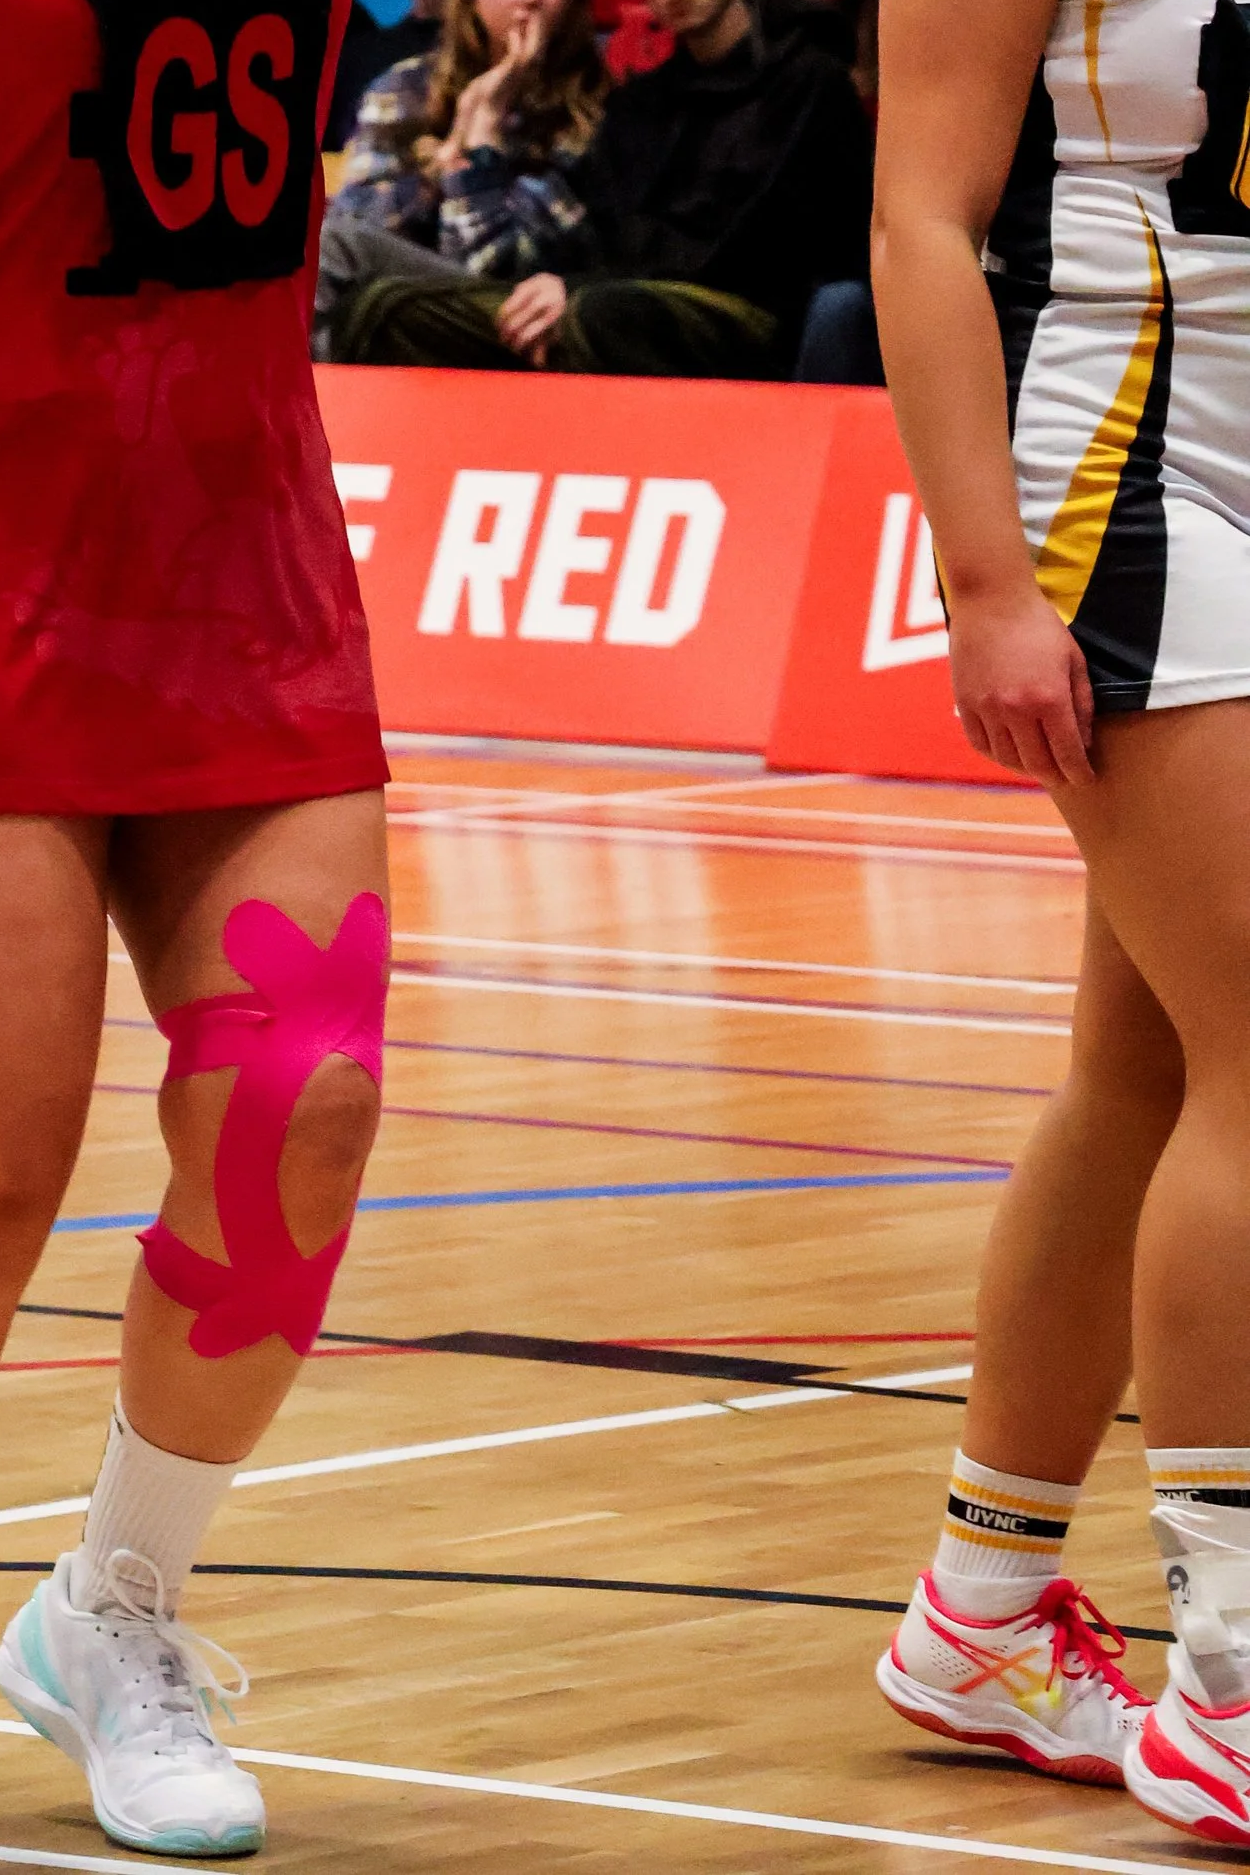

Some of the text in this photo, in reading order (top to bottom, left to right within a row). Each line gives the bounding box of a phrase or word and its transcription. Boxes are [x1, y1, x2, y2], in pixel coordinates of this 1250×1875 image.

[126, 13, 295, 232] GS
[416, 468, 728, 648] RED
[965, 1504, 1028, 1533] UYNC
